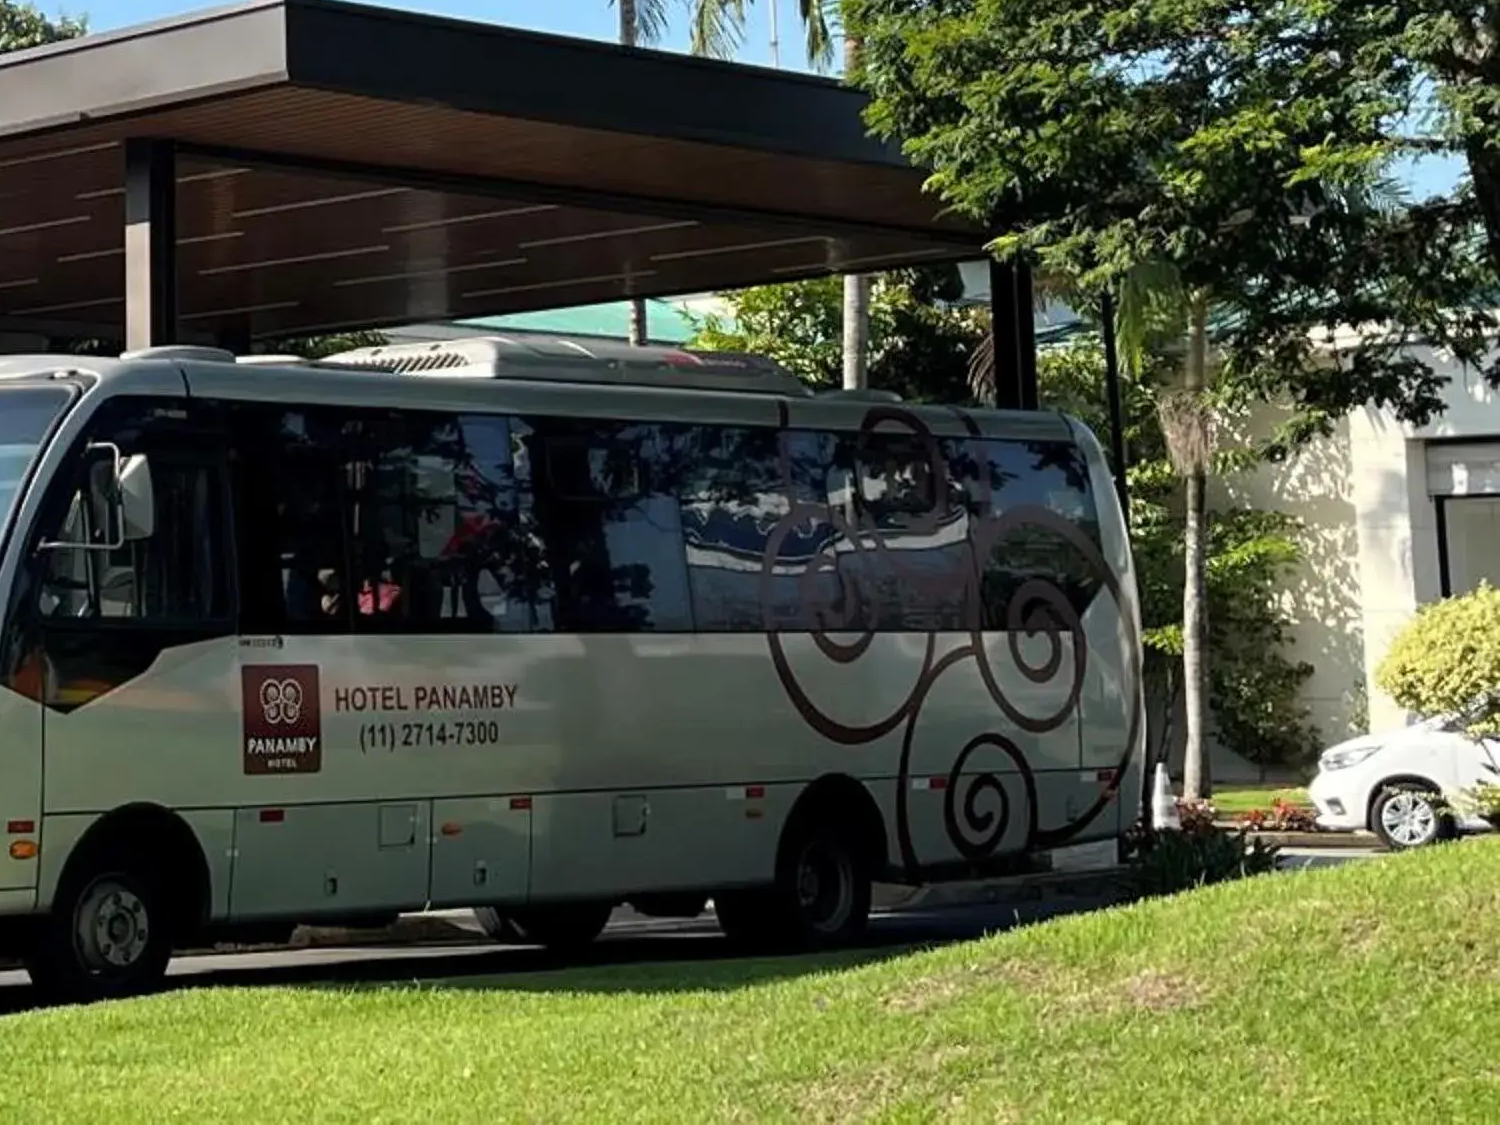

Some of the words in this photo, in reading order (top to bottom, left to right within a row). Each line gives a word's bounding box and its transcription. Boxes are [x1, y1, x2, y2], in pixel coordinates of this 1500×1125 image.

[335, 687, 408, 712] HOTEL
[414, 684, 518, 711] PANAMBY
[246, 737, 317, 755] PANAMBY
[359, 723, 395, 754] (11)
[401, 721, 499, 747] 2714-7300
